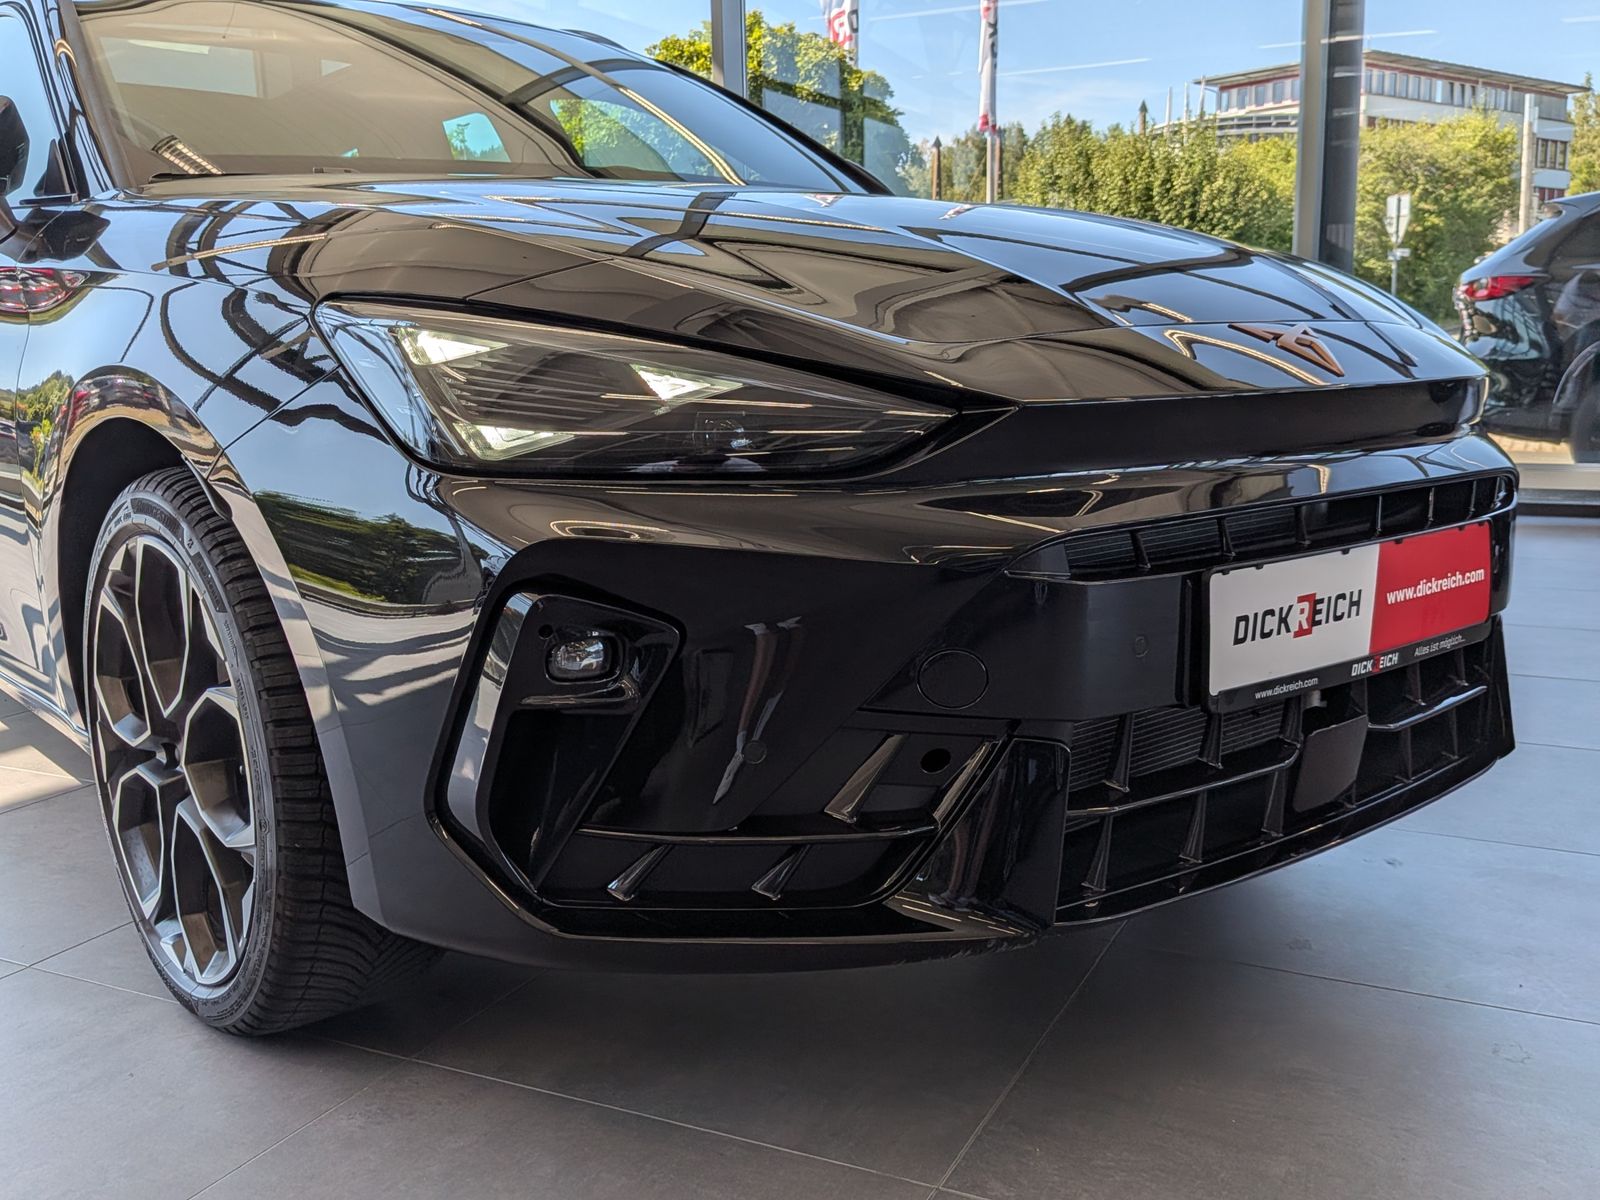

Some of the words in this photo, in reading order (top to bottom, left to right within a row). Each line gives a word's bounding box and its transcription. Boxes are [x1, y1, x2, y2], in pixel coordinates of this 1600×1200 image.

[1386, 568, 1485, 605] www.dickreich.com
[1233, 589, 1362, 646] DICKREICH
[1414, 645, 1430, 657] Alles
[1430, 641, 1439, 652] ist
[1254, 677, 1319, 700] www.dickreich.com
